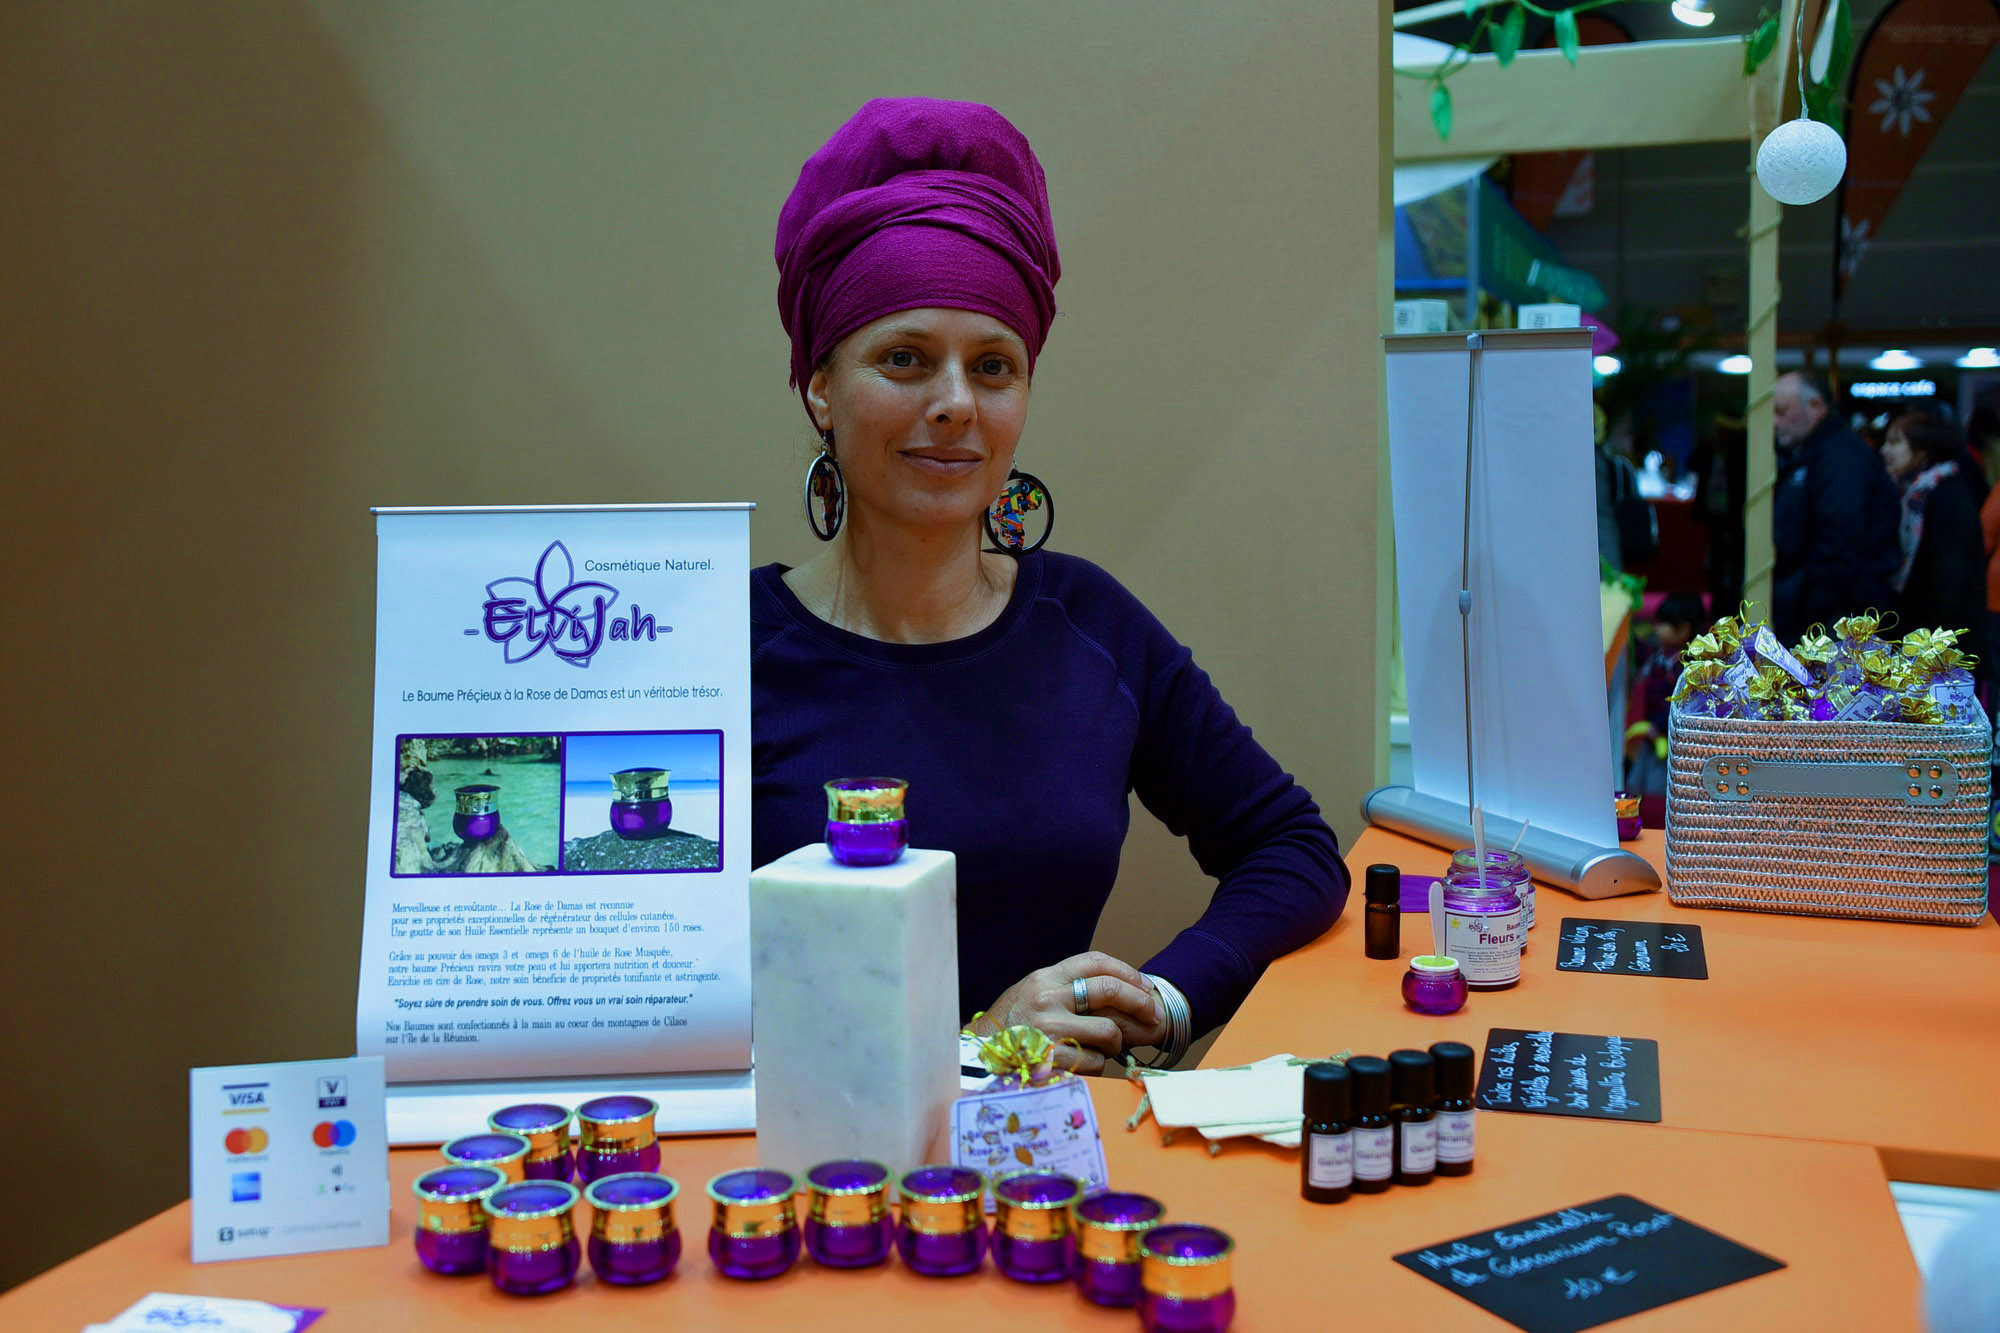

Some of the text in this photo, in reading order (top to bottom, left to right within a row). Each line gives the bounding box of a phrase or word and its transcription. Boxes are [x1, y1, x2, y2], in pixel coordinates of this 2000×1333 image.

[584, 558, 714, 574] Cosmétique Naturel.
[402, 690, 414, 702] Le
[417, 689, 454, 701] Baume
[503, 688, 511, 700] à
[513, 688, 523, 700] la
[526, 688, 550, 700] Rose
[553, 688, 568, 699] de
[570, 687, 607, 699] Damas
[609, 687, 625, 699] est
[627, 689, 640, 699] un
[643, 687, 690, 700] véritable
[692, 685, 723, 698] trésor.
[392, 902, 440, 912] Merveilleuse
[443, 904, 450, 912] et
[510, 901, 520, 911] La
[524, 900, 542, 911] Rose
[544, 900, 553, 912] de
[557, 900, 583, 912] Damas
[585, 901, 596, 909] est
[599, 902, 634, 911] reconnue
[467, 913, 525, 924] exceptionnelles
[527, 912, 537, 922] de
[540, 912, 591, 924] régénérateur
[594, 912, 607, 921] des
[609, 911, 637, 923] cellules
[391, 925, 407, 936] Une
[409, 925, 433, 937] goutte
[436, 925, 445, 936] de
[464, 924, 485, 935] Huile
[488, 925, 529, 935] Essentielle
[589, 923, 619, 935] bouquet
[664, 923, 679, 933] 150
[1479, 933, 1515, 945] Fleurs
[427, 950, 456, 962] pouvoir
[459, 949, 472, 959] des
[474, 952, 498, 961] omega
[502, 949, 508, 959] 3
[511, 951, 518, 959] et
[525, 951, 549, 960] omega
[552, 948, 558, 958] 6
[561, 948, 570, 960] de
[602, 947, 611, 957] de
[614, 947, 632, 957] Rose
[635, 947, 672, 959] Musquée,
[1560, 947, 1586, 968] Baume
[388, 965, 409, 973] notre
[412, 963, 437, 972] baume
[440, 962, 474, 972] Précieux
[478, 962, 501, 971] ravira
[505, 963, 525, 971] votre
[528, 964, 546, 972] peau
[549, 962, 556, 970] et
[560, 960, 570, 970] lui
[573, 961, 611, 971] apportera
[614, 959, 648, 969] nutrition
[651, 960, 659, 968] et
[387, 975, 420, 986] Enrichie
[435, 975, 450, 985] cire
[453, 974, 462, 984] de
[465, 974, 486, 985] Rose,
[489, 976, 510, 984] notre
[513, 974, 528, 983] soin
[569, 973, 579, 983] de
[624, 972, 662, 982] tonifiante
[664, 972, 672, 981] et
[675, 971, 720, 983] astringente.
[444, 998, 454, 1007] de
[456, 997, 488, 1009] prendre
[490, 996, 508, 1006] soin
[510, 996, 520, 1006] de
[522, 998, 544, 1006] vous.
[546, 996, 571, 1006] Offrez
[573, 997, 592, 1005] vous
[595, 997, 605, 1005] un
[608, 994, 623, 1004] vrai
[625, 994, 642, 1004] soin
[386, 1020, 401, 1031] Nos
[404, 1020, 434, 1031] Baumes
[437, 1021, 454, 1032] sont
[456, 1019, 510, 1029] confectionnés
[512, 1018, 518, 1029] à
[521, 1018, 528, 1029] la
[531, 1018, 551, 1028] main
[591, 1017, 605, 1028] des
[607, 1018, 649, 1029] montagnes
[651, 1016, 661, 1026] de
[419, 1032, 429, 1043] de
[432, 1032, 440, 1043] la
[443, 1032, 479, 1042] Réunion.
[1563, 1053, 1587, 1067] de
[1482, 1041, 1520, 1106] Toutes nos huiles
[230, 1080, 339, 1105] VISA V
[1418, 1242, 1492, 1271] Huile
